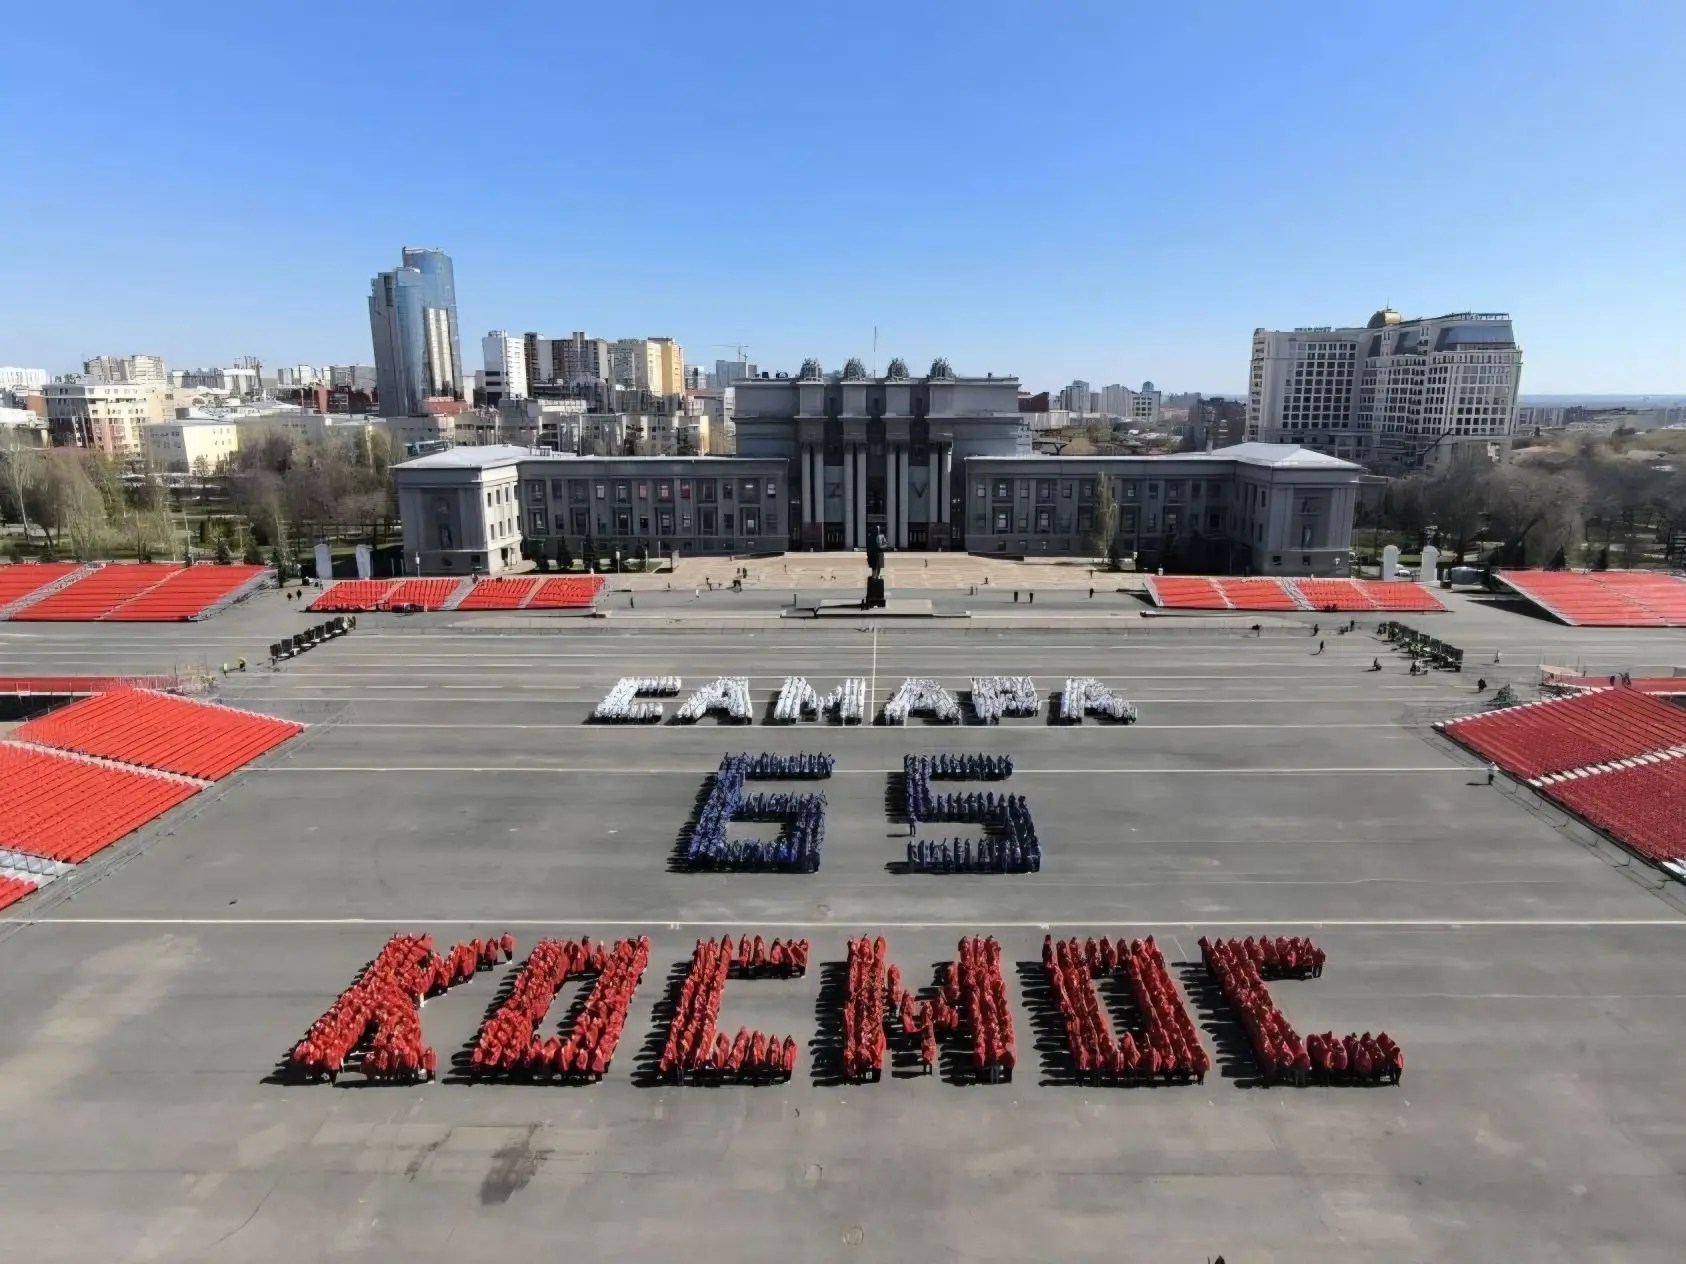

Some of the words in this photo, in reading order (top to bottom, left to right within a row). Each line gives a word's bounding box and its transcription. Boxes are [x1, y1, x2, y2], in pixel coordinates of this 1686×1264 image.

[824, 482, 841, 499] Z
[911, 482, 929, 499] V
[594, 675, 1138, 723] САМАРА
[686, 752, 1042, 872] 65
[292, 932, 1404, 1084] КОСМОС
